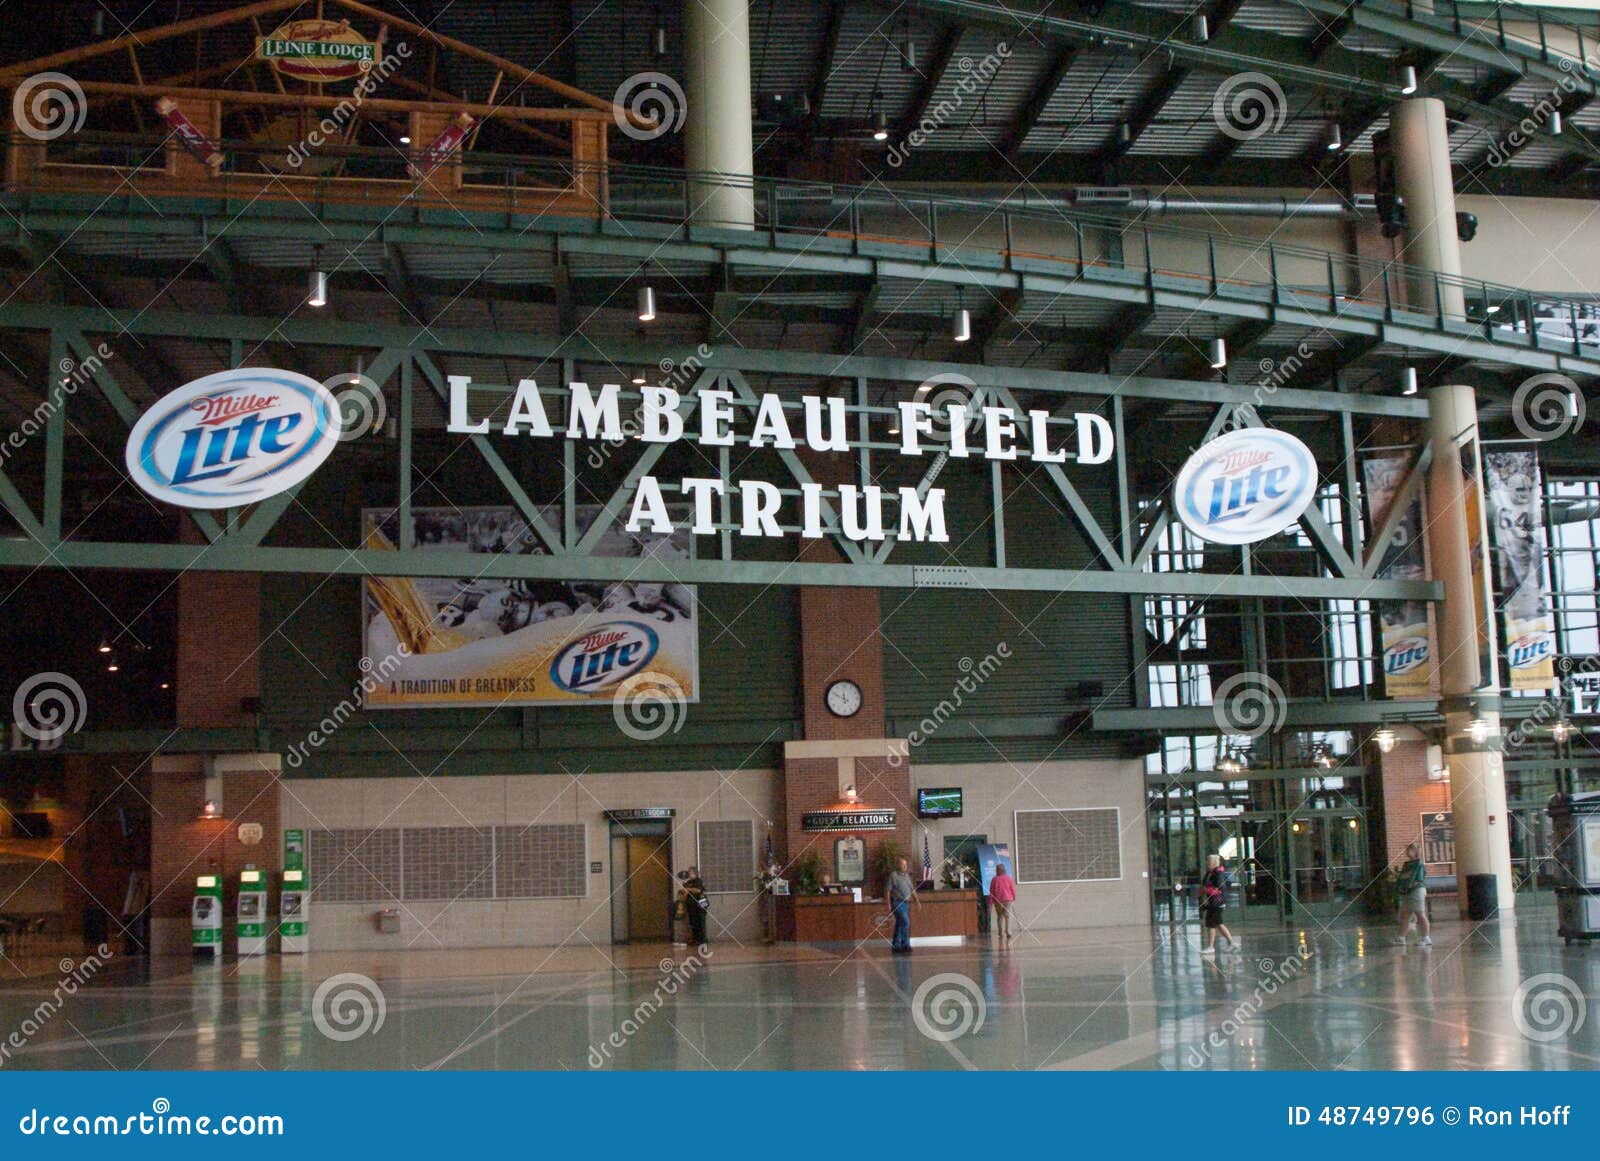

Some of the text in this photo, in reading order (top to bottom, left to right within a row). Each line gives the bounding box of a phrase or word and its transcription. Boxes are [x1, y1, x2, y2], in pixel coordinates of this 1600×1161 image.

[265, 40, 373, 61] LEINIE LODGE
[190, 393, 280, 425] Miller
[447, 375, 1115, 465] LAMBEAU FIELD
[168, 412, 302, 487] Lite
[1219, 450, 1275, 476] Miller
[625, 476, 950, 543] ATRIUM
[1206, 465, 1291, 525] Lite
[579, 632, 629, 653] Miller
[568, 641, 643, 689] Lite
[390, 678, 536, 694] A TRADITION OF GREATNESS
[813, 815, 889, 825] GUEST RELATIONS
